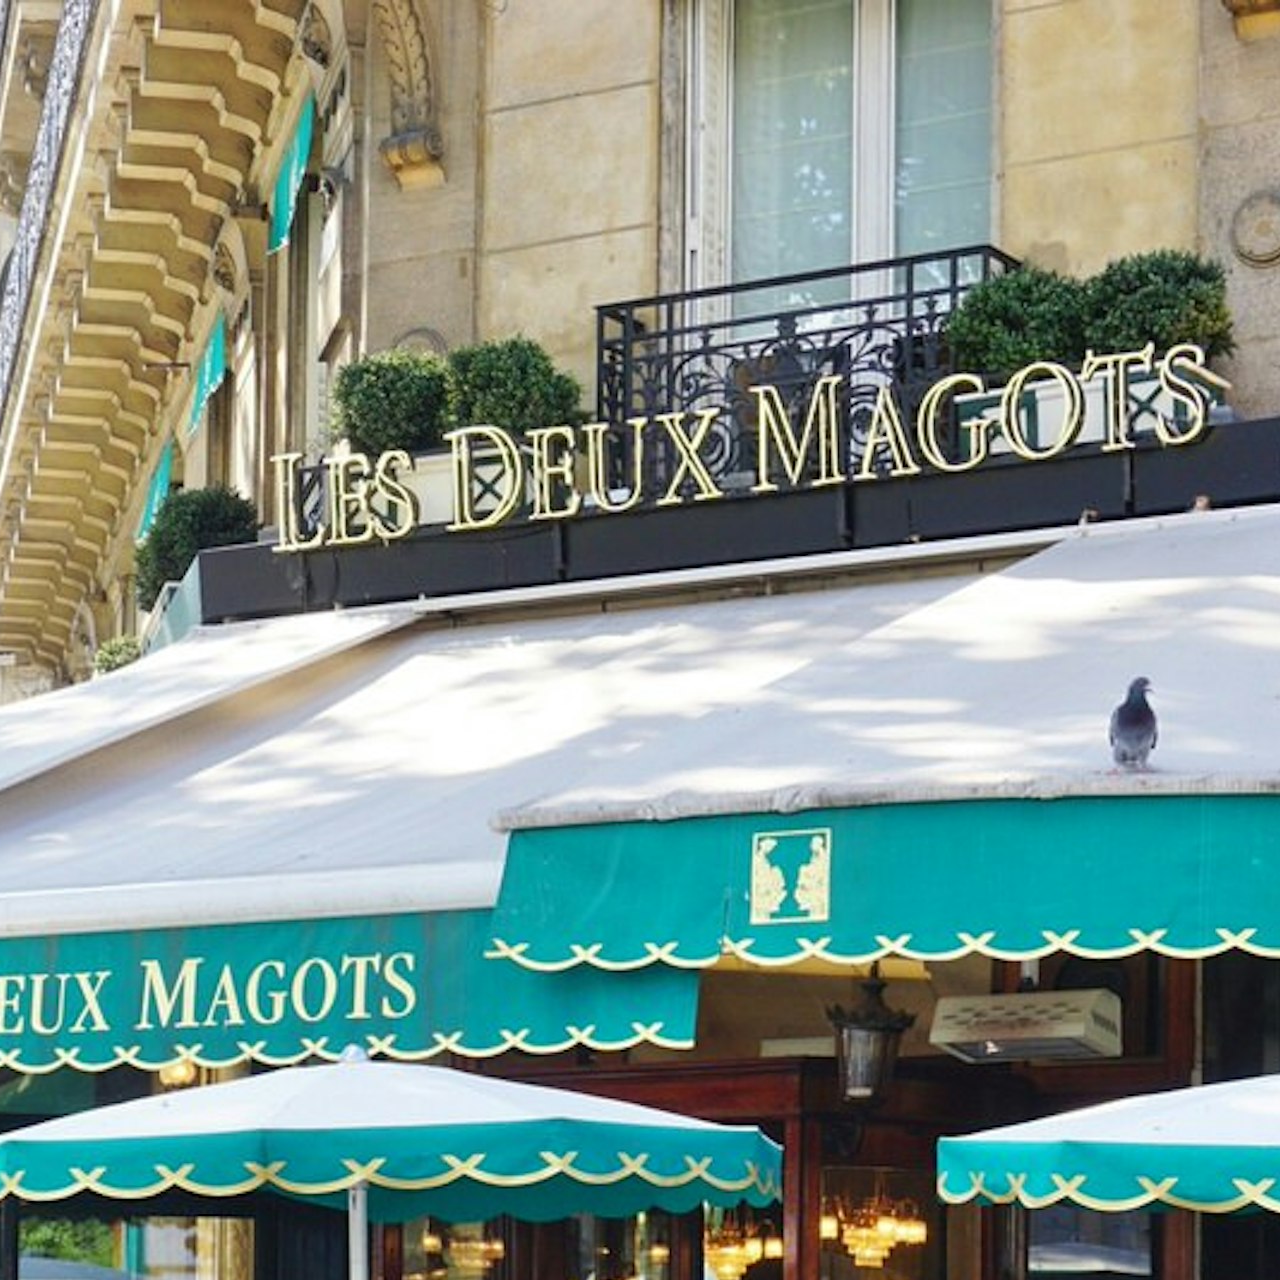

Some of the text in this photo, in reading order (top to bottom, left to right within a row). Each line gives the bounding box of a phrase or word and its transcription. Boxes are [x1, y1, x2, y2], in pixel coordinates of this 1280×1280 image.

[271, 343, 1206, 553] LES DEUX MAGOTS
[134, 952, 417, 1031] MAGOTS
